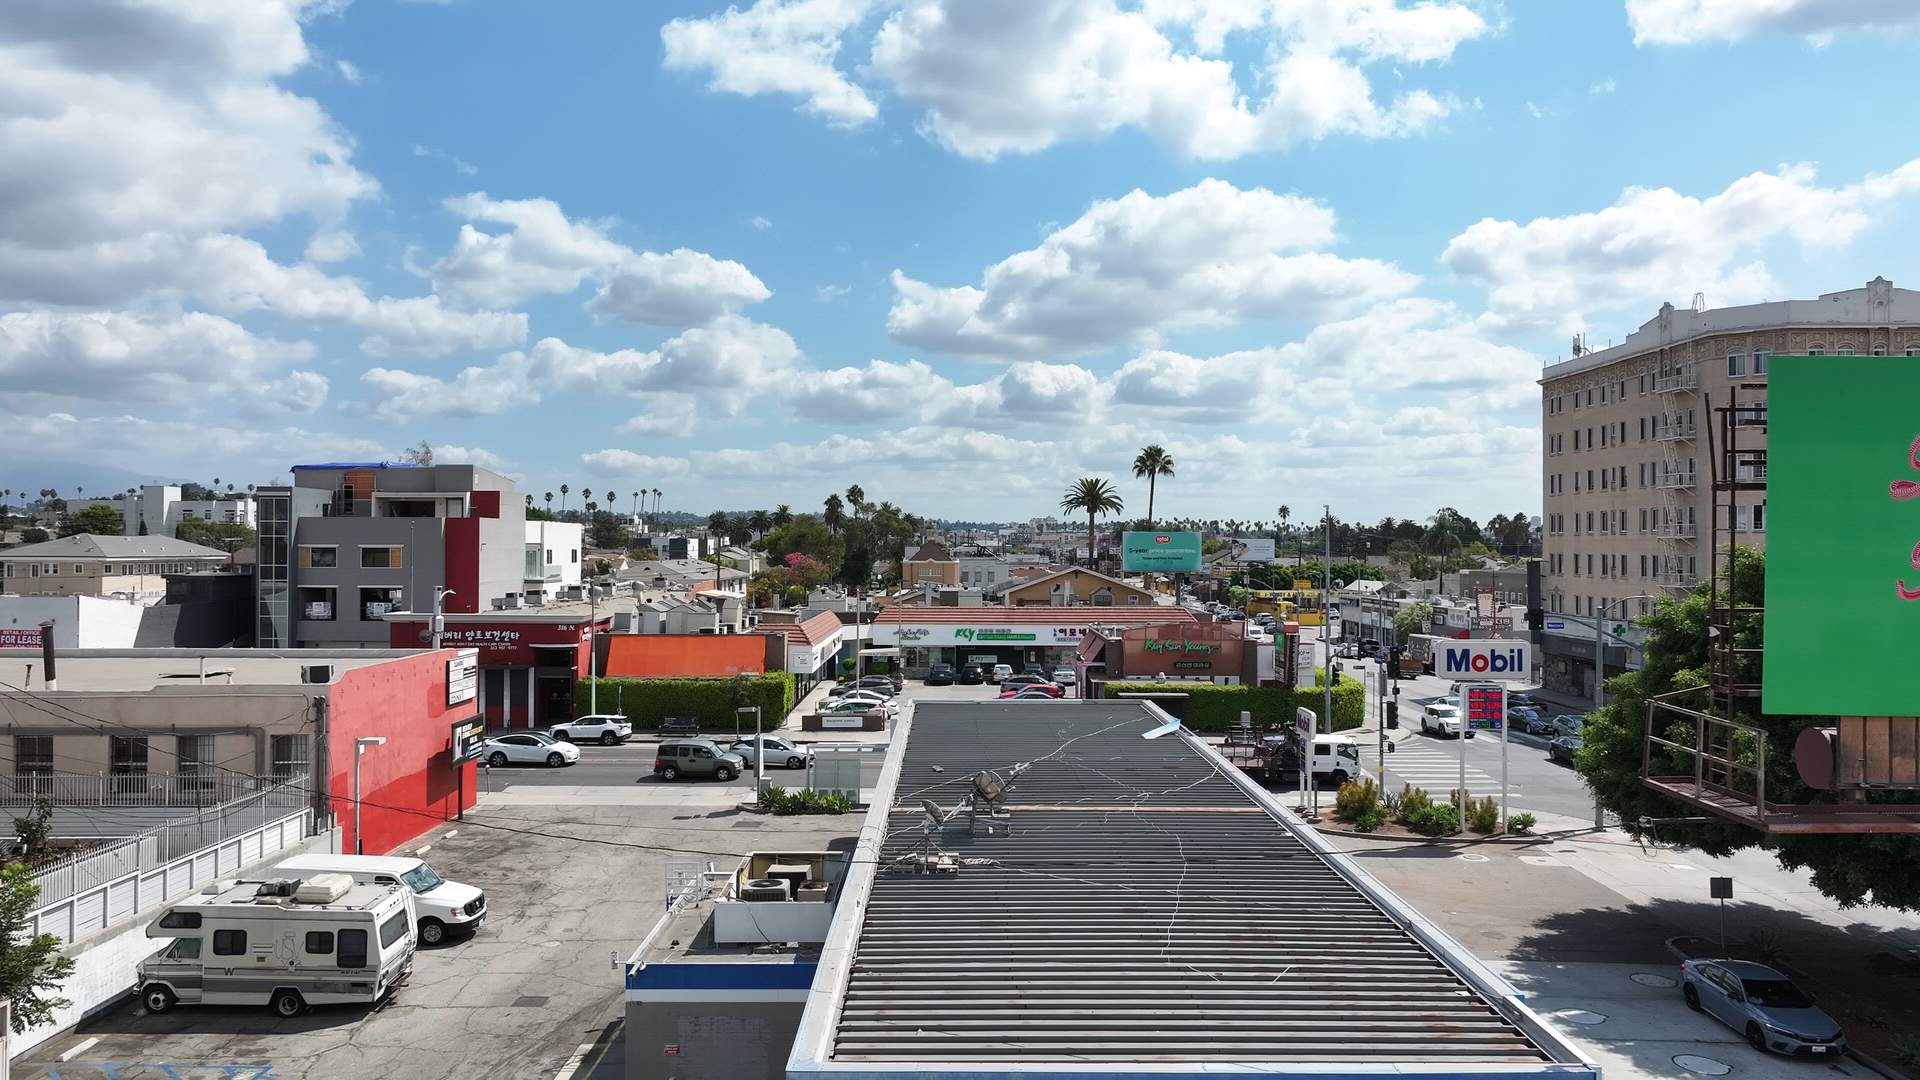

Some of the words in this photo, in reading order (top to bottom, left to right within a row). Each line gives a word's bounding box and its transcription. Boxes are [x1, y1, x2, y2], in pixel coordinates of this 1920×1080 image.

[0, 635, 16, 644] FOR
[17, 635, 42, 644] LEASE
[1446, 648, 1523, 673] Mobil
[224, 968, 234, 976] W
